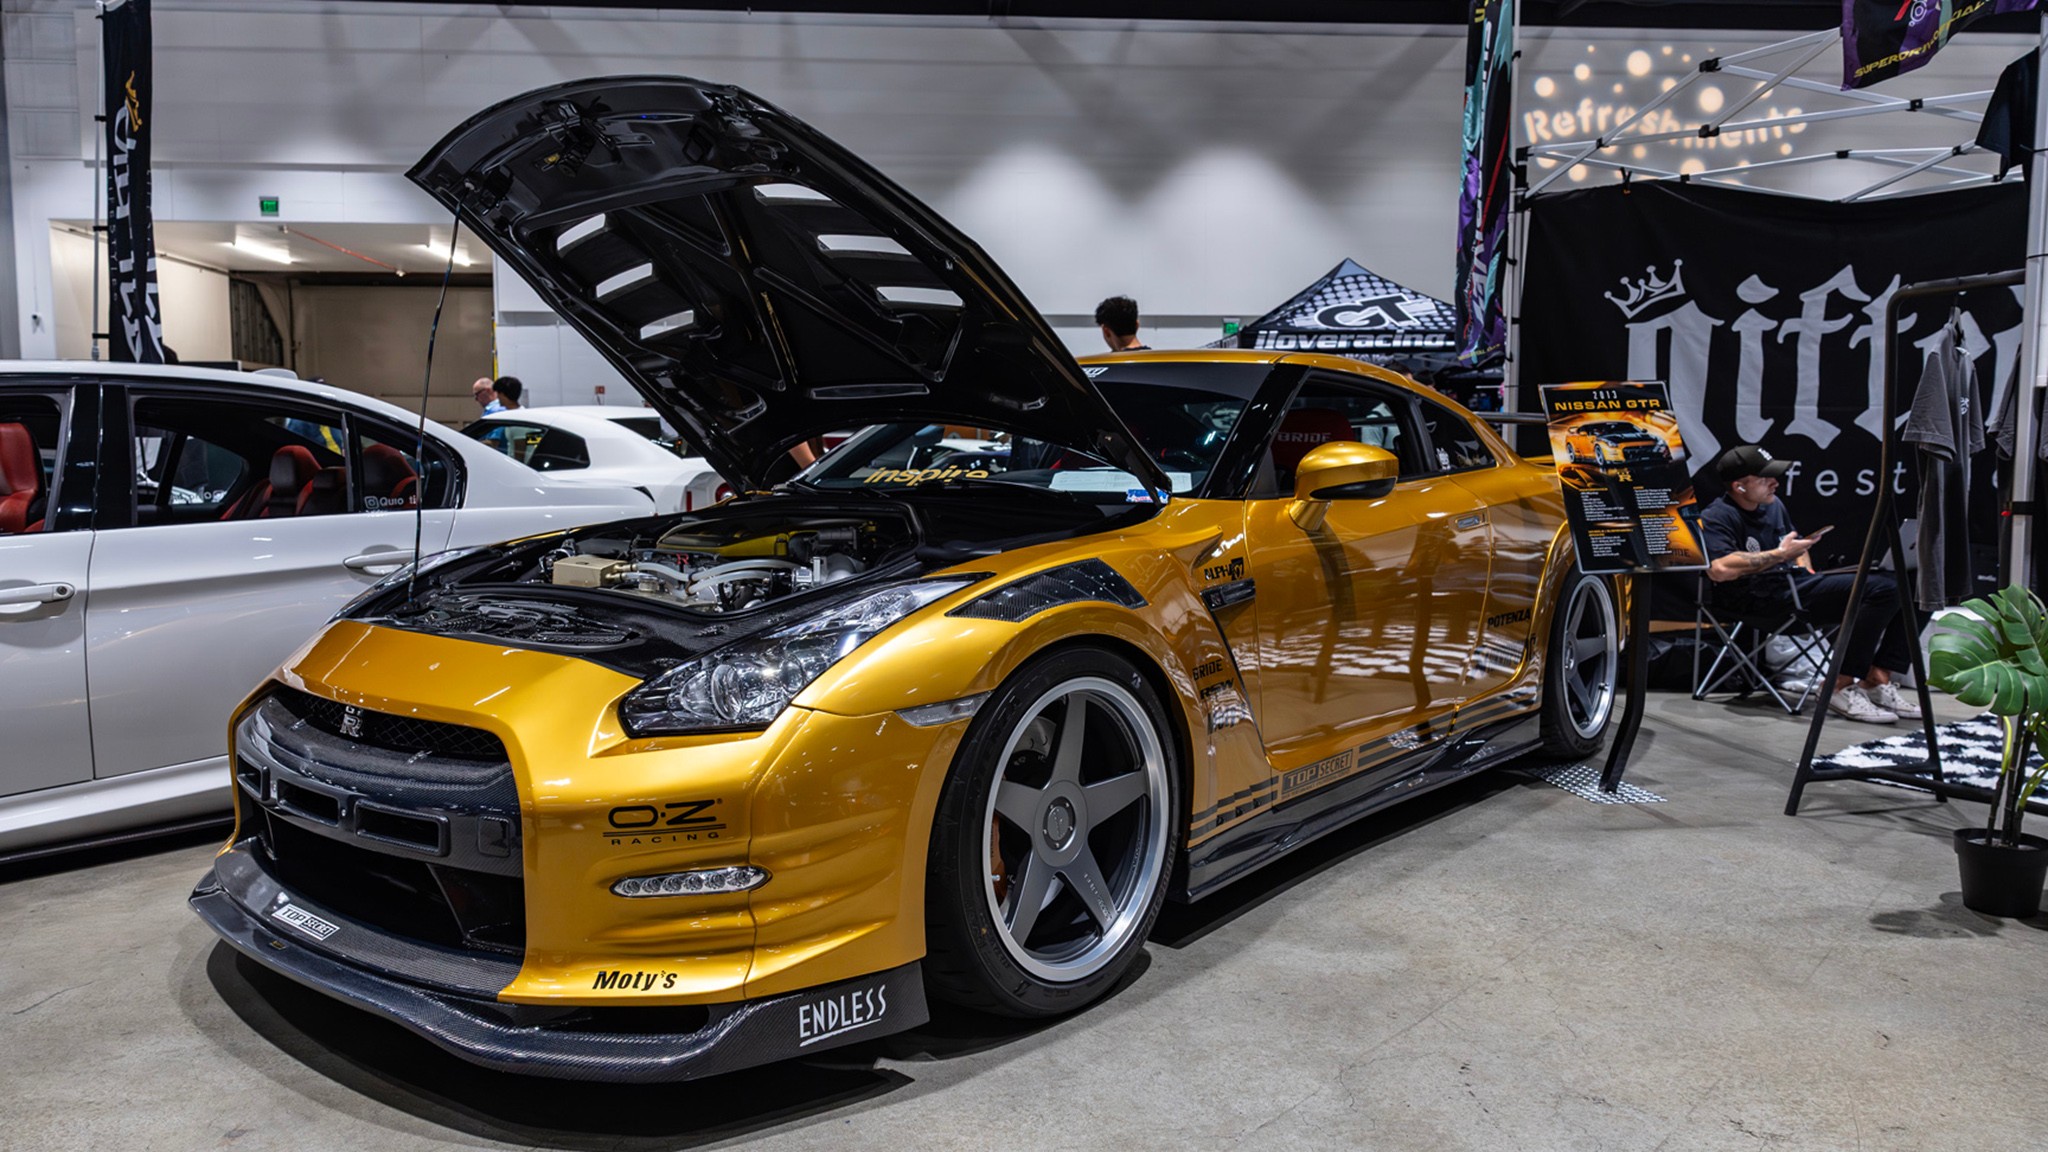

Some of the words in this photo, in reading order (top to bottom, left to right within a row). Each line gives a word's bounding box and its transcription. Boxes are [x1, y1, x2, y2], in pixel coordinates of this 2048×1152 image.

[1314, 293, 1420, 330] GT
[1555, 400, 1621, 411] NISSAN
[1626, 399, 1661, 409] GTR
[1592, 390, 1618, 400] 2013
[1278, 432, 1331, 443] BRIDE
[863, 464, 989, 487] inspire
[1487, 608, 1531, 630] POTENZA
[1192, 659, 1223, 681] BRIDE
[1287, 765, 1317, 788] TOP
[1319, 752, 1351, 777] SECRET
[611, 832, 720, 845] RACING
[281, 908, 306, 921] TOP
[303, 917, 336, 936] SECRET
[592, 970, 678, 991] Moty's
[799, 985, 888, 1042] ENDLESS
